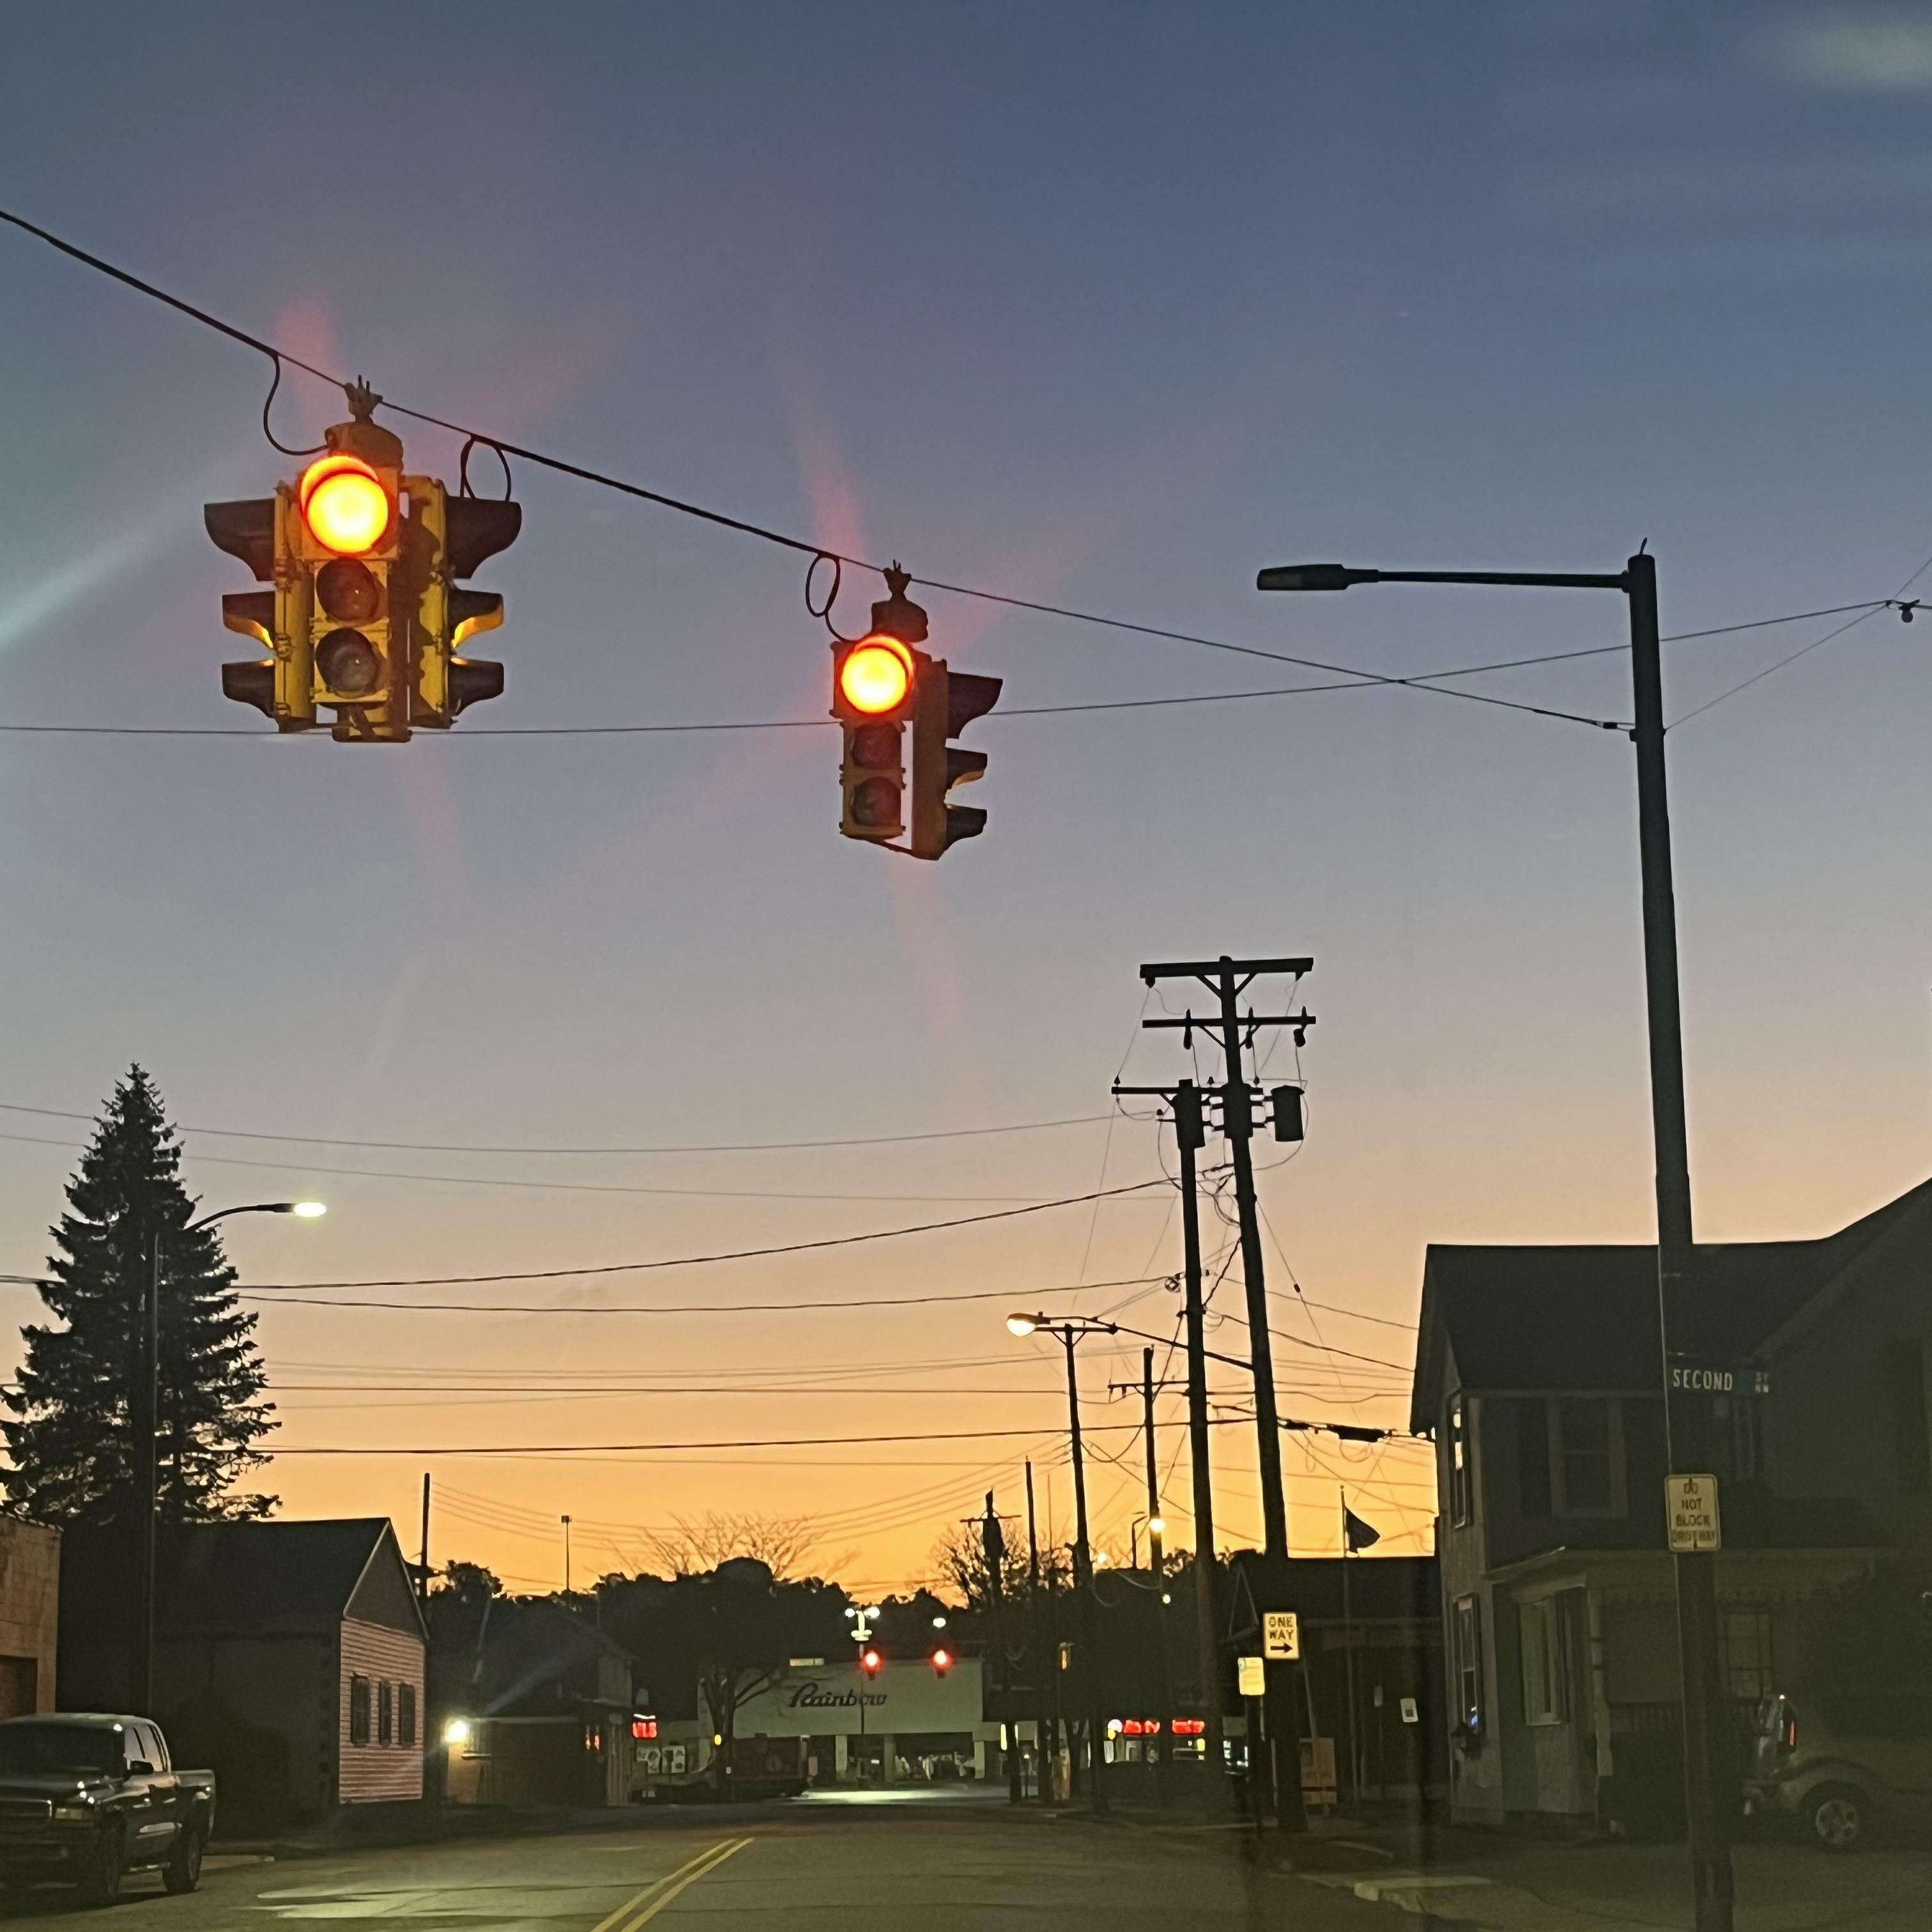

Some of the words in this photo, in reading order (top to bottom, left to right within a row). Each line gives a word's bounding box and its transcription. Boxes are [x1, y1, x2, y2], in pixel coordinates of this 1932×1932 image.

[1671, 1368, 1733, 1391] SECOND
[1683, 1482, 1699, 1494] DO
[1681, 1498, 1702, 1510] NOT
[1675, 1514, 1710, 1527] BLOCK
[1268, 1616, 1293, 1628] ONE
[1268, 1629, 1294, 1641] WAY
[788, 1682, 887, 1708] Rainbow
